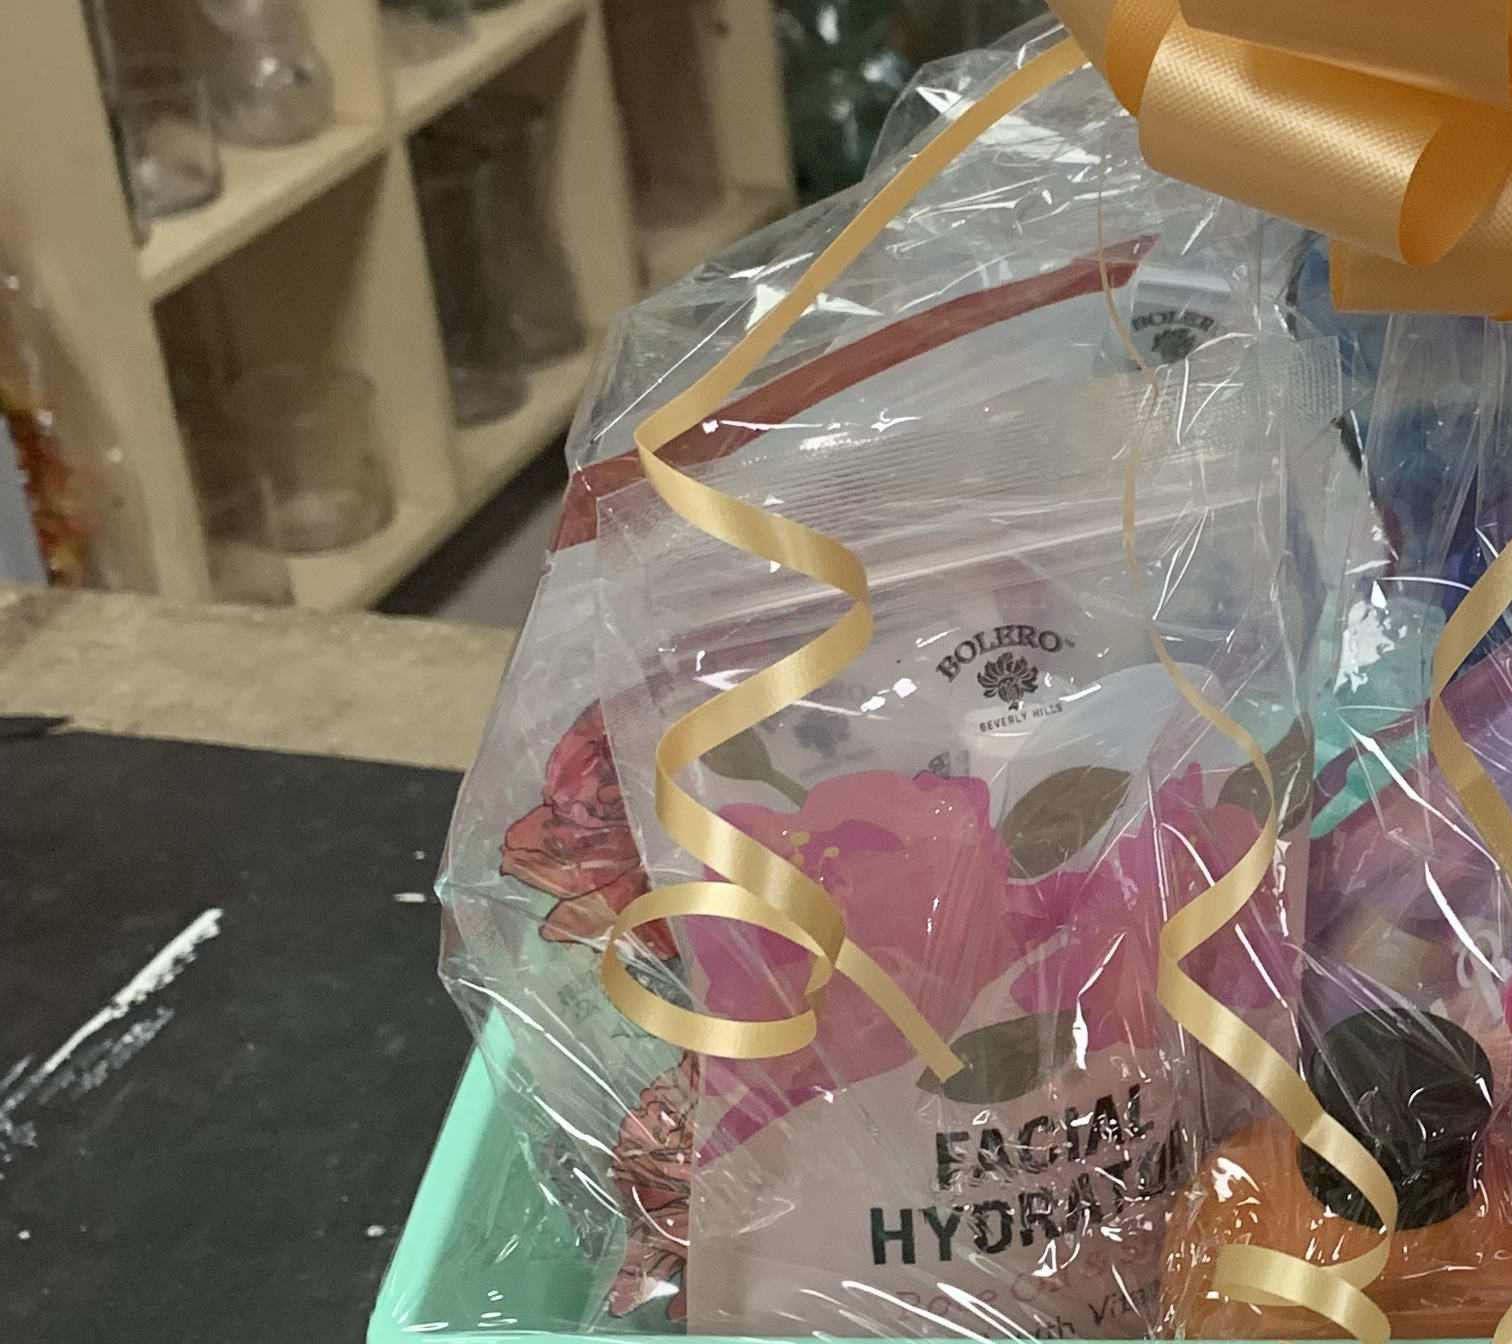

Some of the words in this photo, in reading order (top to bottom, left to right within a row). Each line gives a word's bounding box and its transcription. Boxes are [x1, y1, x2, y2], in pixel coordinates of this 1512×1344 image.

[978, 712, 1028, 733] BEVERLY
[1032, 702, 1064, 720] HILLS
[934, 1082, 1155, 1192] FACIAL
